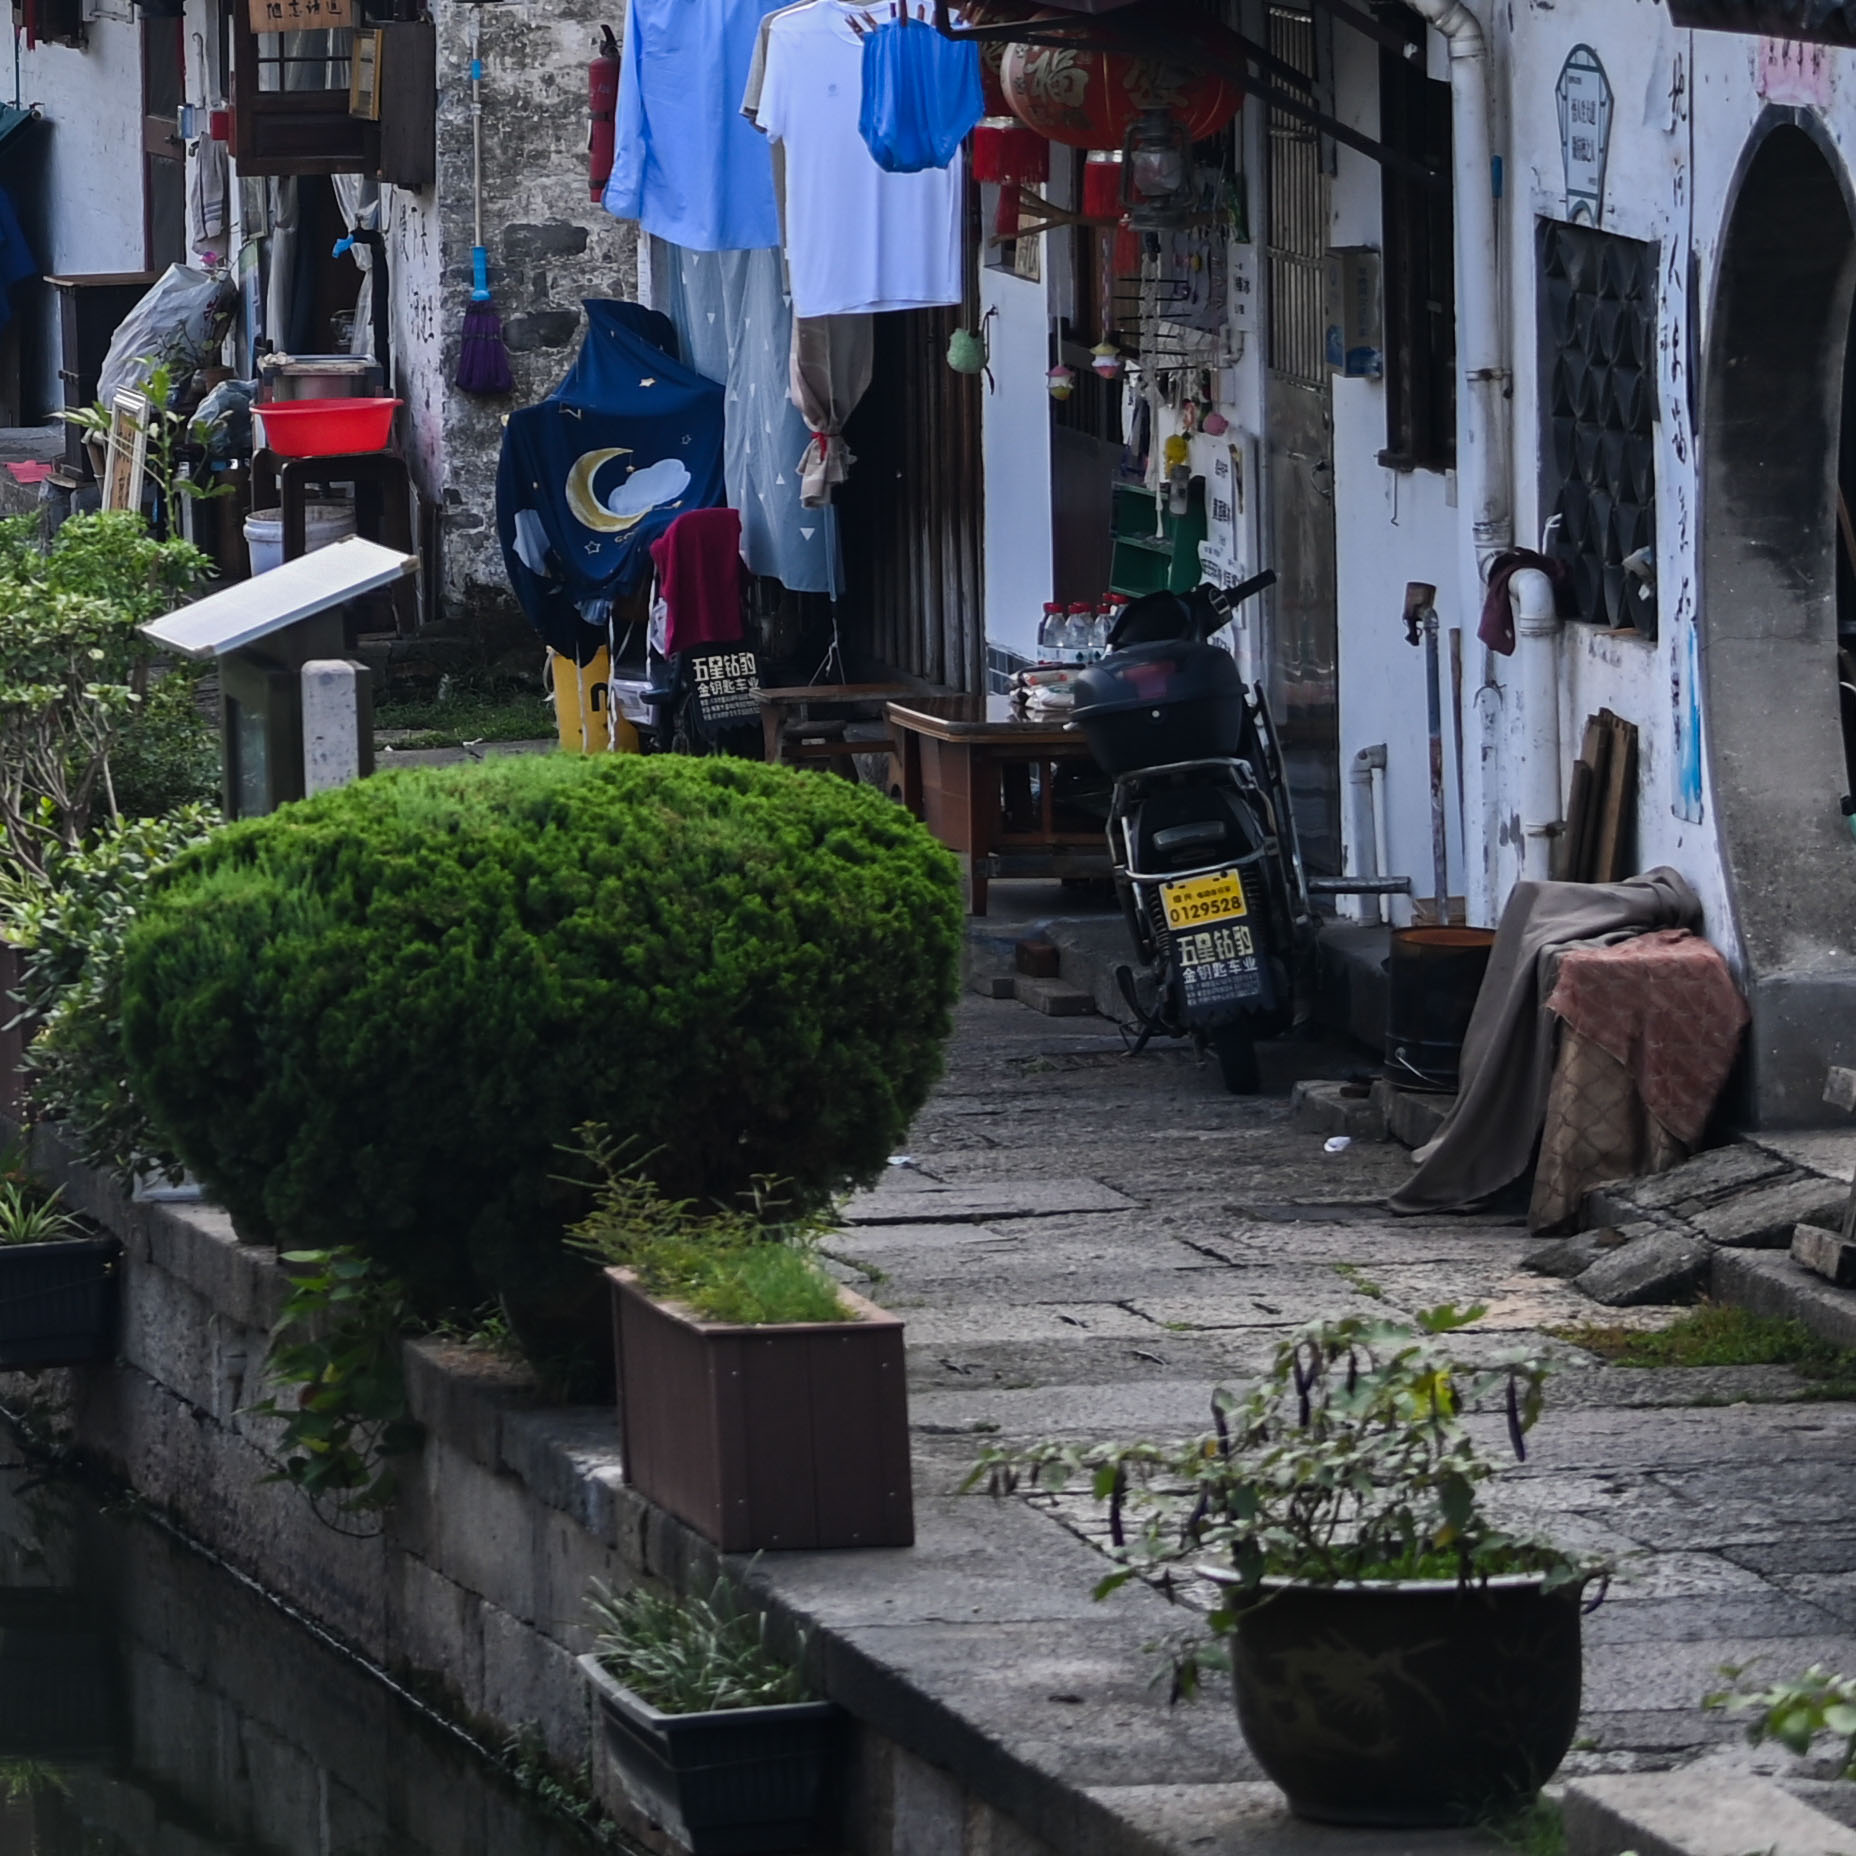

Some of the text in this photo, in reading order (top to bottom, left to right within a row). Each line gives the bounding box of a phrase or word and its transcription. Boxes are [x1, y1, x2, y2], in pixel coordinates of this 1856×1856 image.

[691, 652, 757, 682] 五星钻豹
[697, 676, 761, 698] 金钥匙车业
[1170, 896, 1241, 923] 0129528
[1176, 925, 1254, 967] 五星钻豹
[1182, 956, 1258, 984] 金钥匙车业
